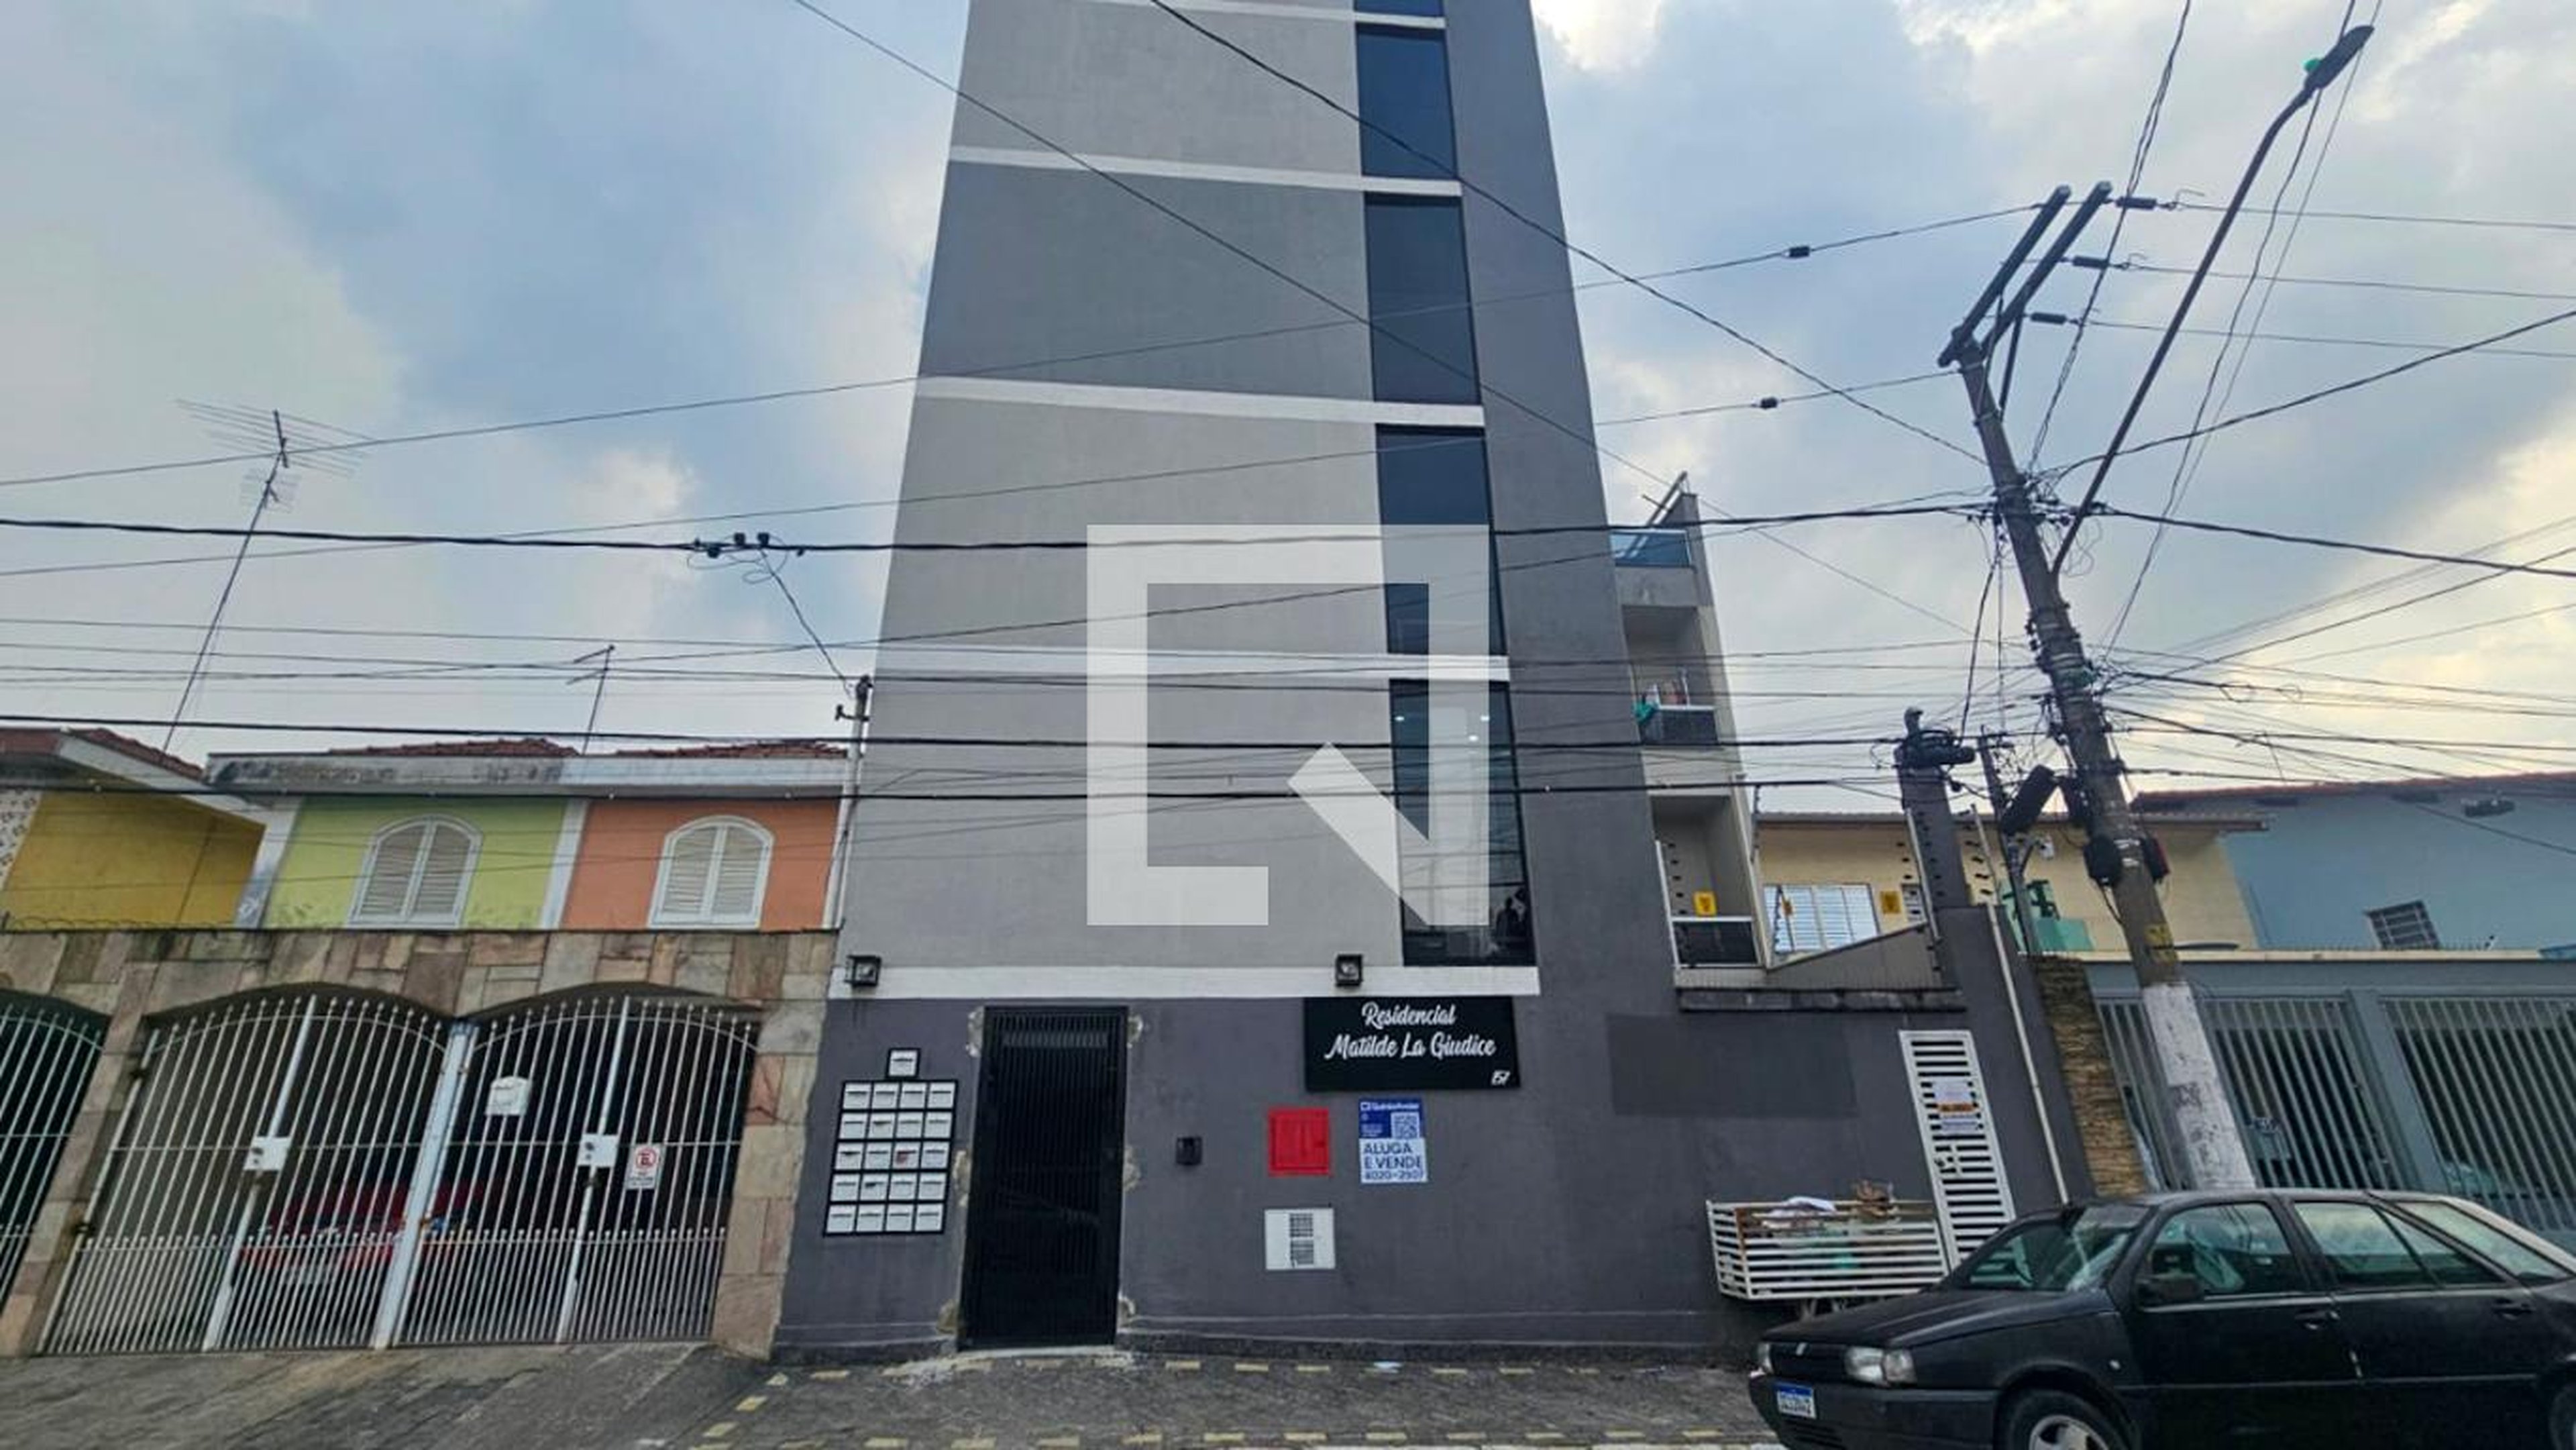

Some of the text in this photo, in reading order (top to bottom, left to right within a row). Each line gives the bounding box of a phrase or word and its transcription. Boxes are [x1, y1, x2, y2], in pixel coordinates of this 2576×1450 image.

[1361, 1001, 1456, 1030] Residencial
[1324, 1031, 1497, 1060] Matilde La Giudice
[1363, 1142, 1413, 1155] ALUGA
[1364, 1155, 1422, 1169] E VENDE
